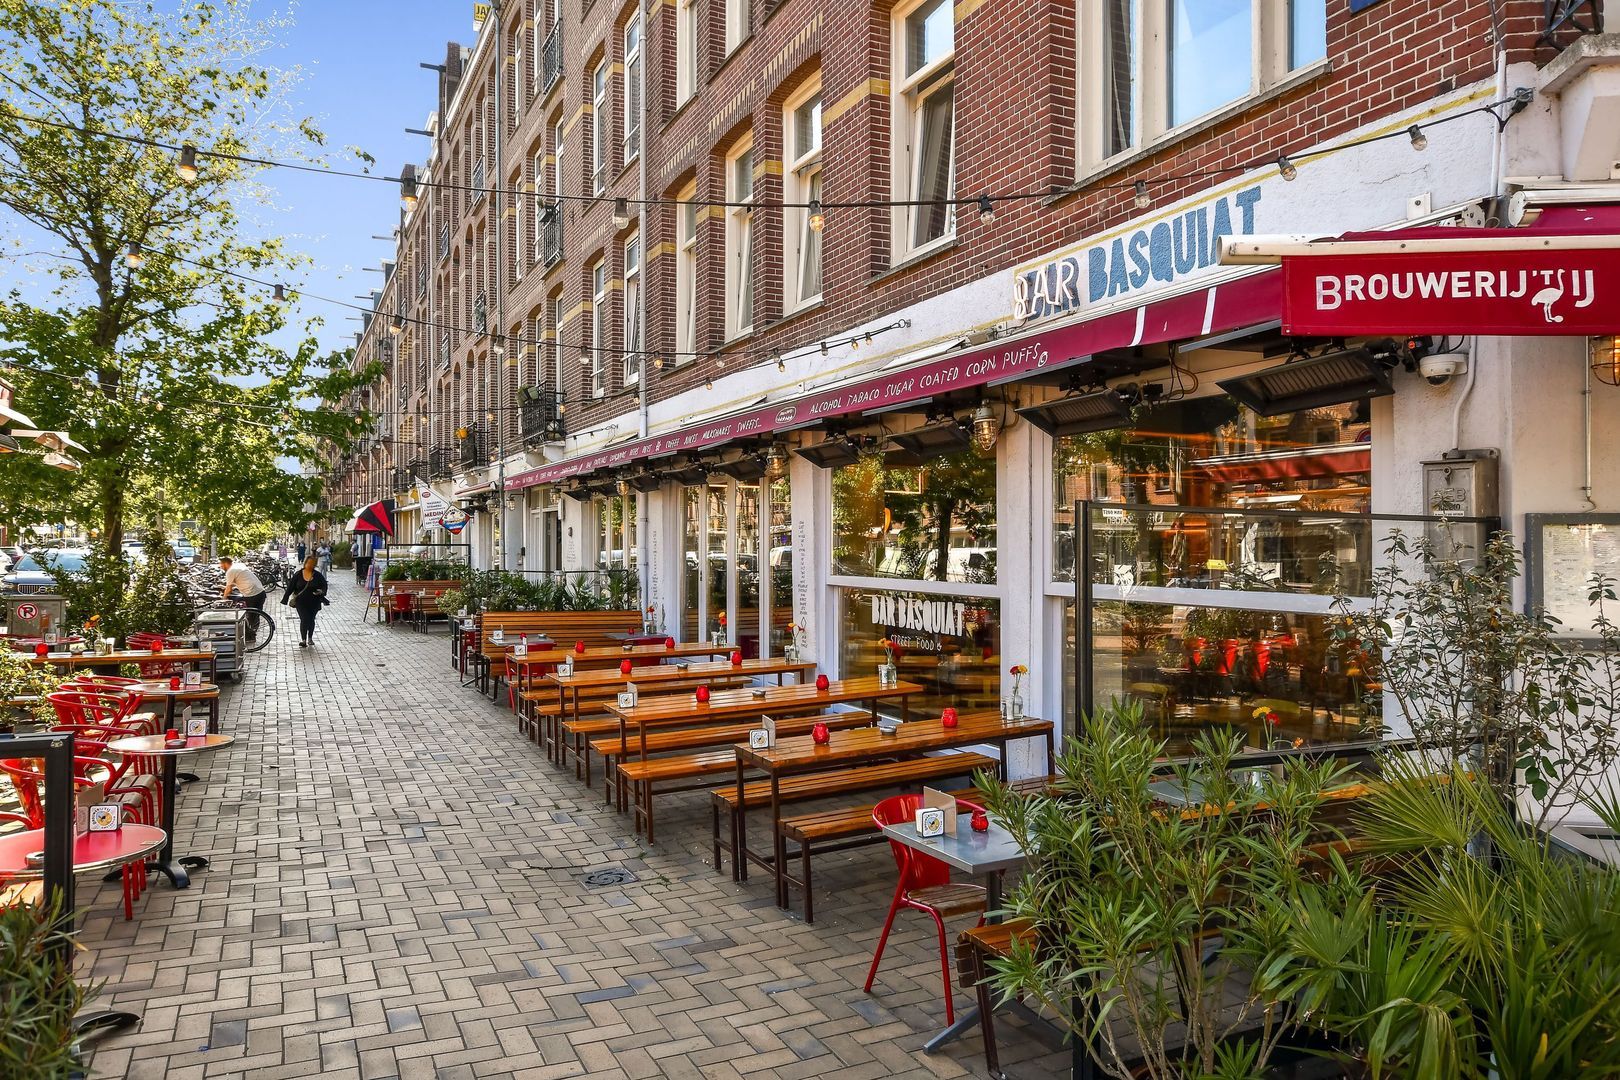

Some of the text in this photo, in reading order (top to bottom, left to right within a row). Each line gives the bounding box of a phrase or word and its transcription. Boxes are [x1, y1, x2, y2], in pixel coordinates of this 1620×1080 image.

[1088, 185, 1262, 304] BASQUIAT
[1315, 269, 1527, 311] BROUWERIJ
[1571, 269, 1595, 308] IJ
[809, 396, 842, 415] ALCOHOL
[846, 388, 880, 407] TABACO
[884, 377, 915, 398] SUGAR
[919, 367, 959, 389] COATED
[965, 355, 997, 378] CORN
[1002, 342, 1041, 370] PUFFS
[871, 595, 965, 637] BAR BASQUIAT
[890, 634, 912, 648] STREET
[916, 637, 935, 651] FOOD
